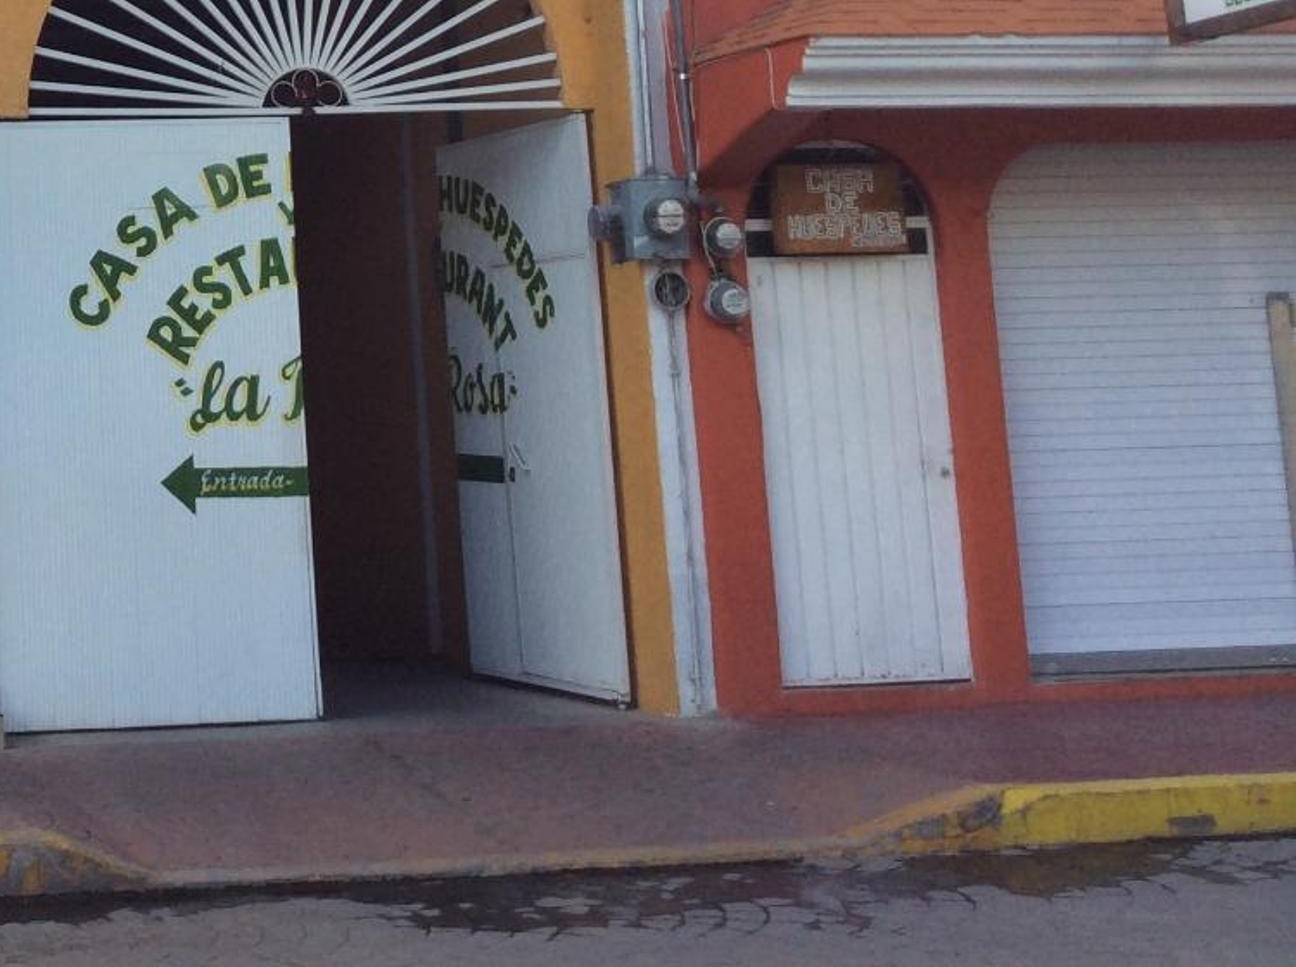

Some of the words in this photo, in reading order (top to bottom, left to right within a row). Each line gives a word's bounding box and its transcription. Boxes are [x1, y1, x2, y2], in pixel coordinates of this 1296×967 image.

[68, 186, 200, 327] CASA
[203, 153, 273, 209] DE
[438, 174, 555, 329] HUESPEDES
[805, 168, 874, 194] CASA
